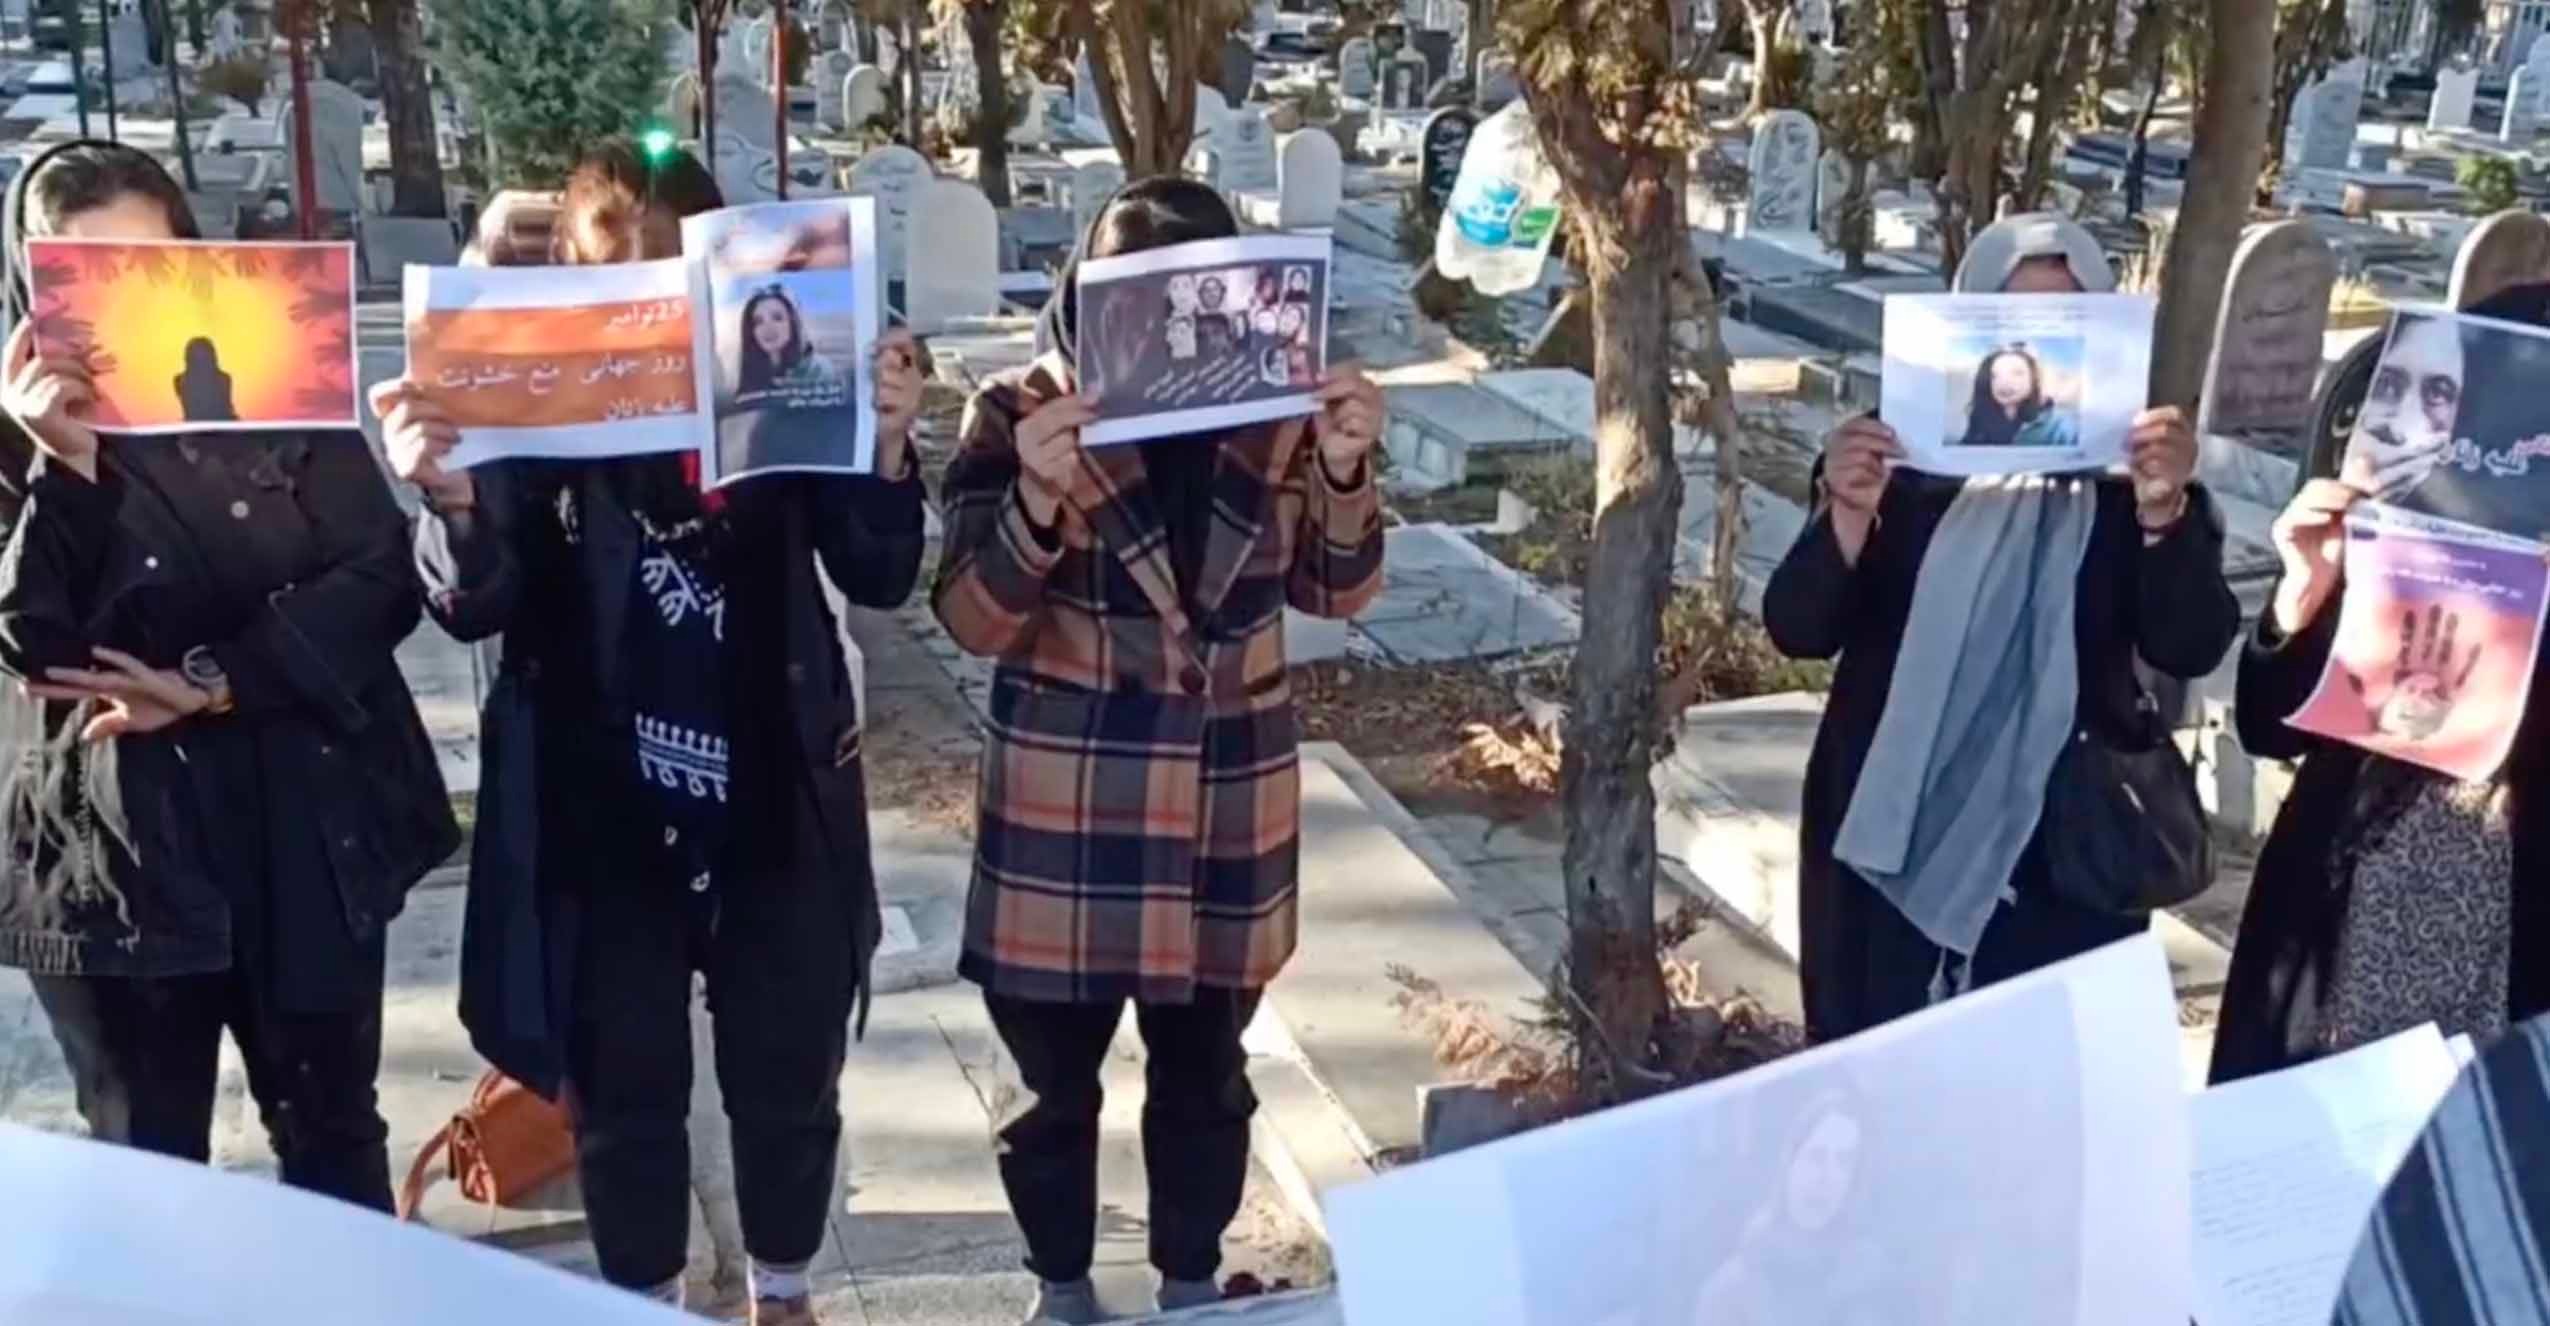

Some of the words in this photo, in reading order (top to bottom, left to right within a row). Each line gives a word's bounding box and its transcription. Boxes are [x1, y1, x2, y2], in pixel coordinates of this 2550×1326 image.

[437, 360, 518, 392] خشونت
[527, 361, 561, 396] منع
[579, 352, 642, 385] جهانی
[650, 352, 687, 375] روز
